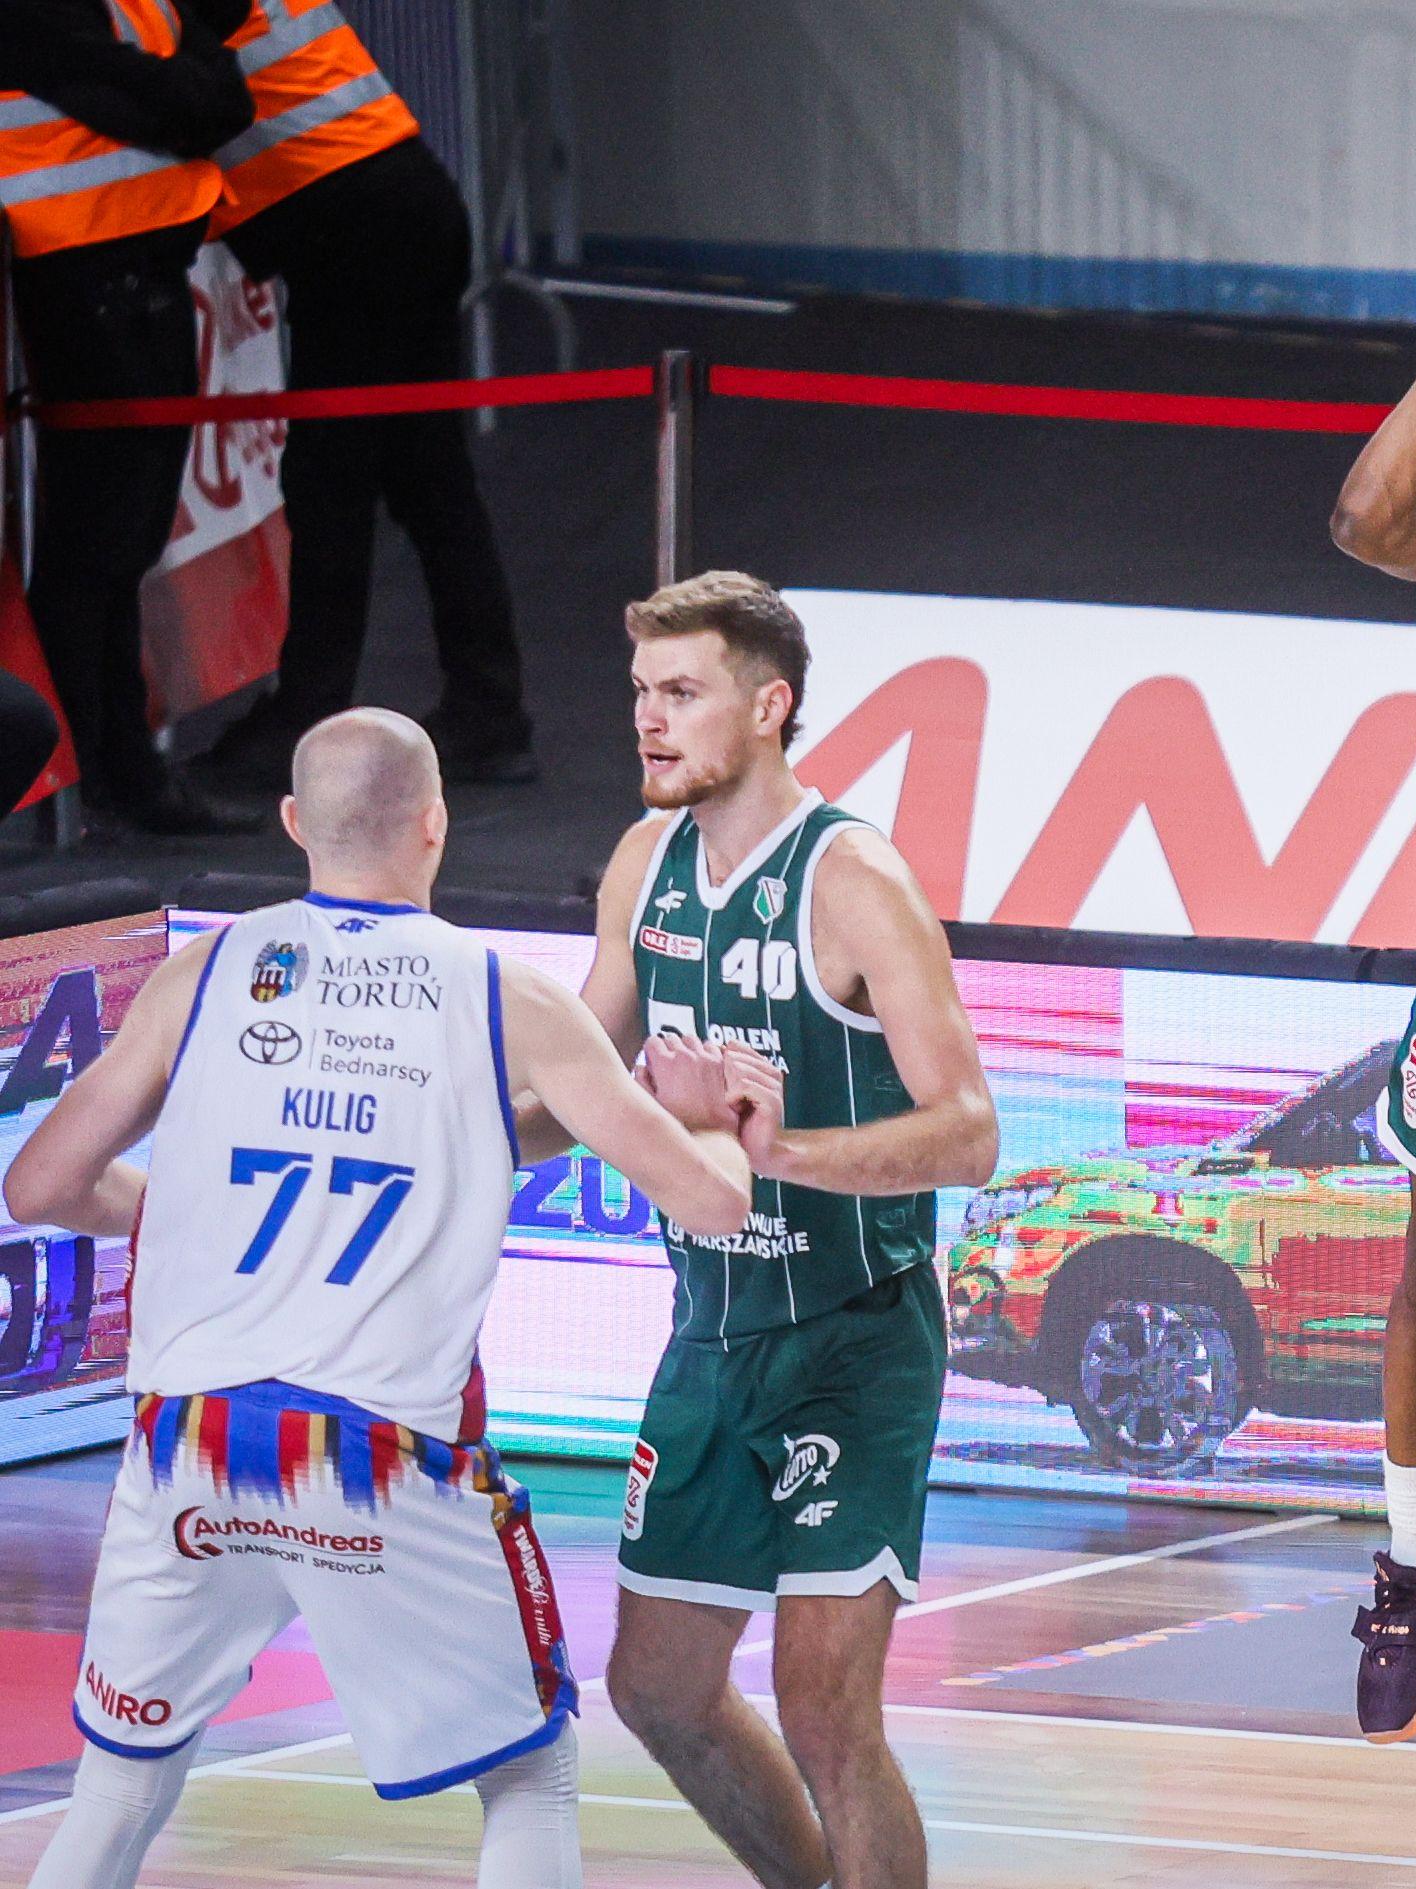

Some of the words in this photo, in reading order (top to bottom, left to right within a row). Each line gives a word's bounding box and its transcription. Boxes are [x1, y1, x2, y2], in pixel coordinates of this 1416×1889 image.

[320, 954, 431, 978] MIASTO
[720, 937, 797, 1001] 40
[324, 1028, 396, 1052] Toyota
[320, 1055, 432, 1088] Bednarscy
[281, 1085, 378, 1137] KULIG
[229, 1146, 416, 1287] 77
[194, 1516, 385, 1553] AutoAndreas
[227, 1543, 305, 1564] TRANSPORT
[312, 1556, 386, 1576] SPEDYCJA
[83, 1657, 172, 1728] ANIRO
